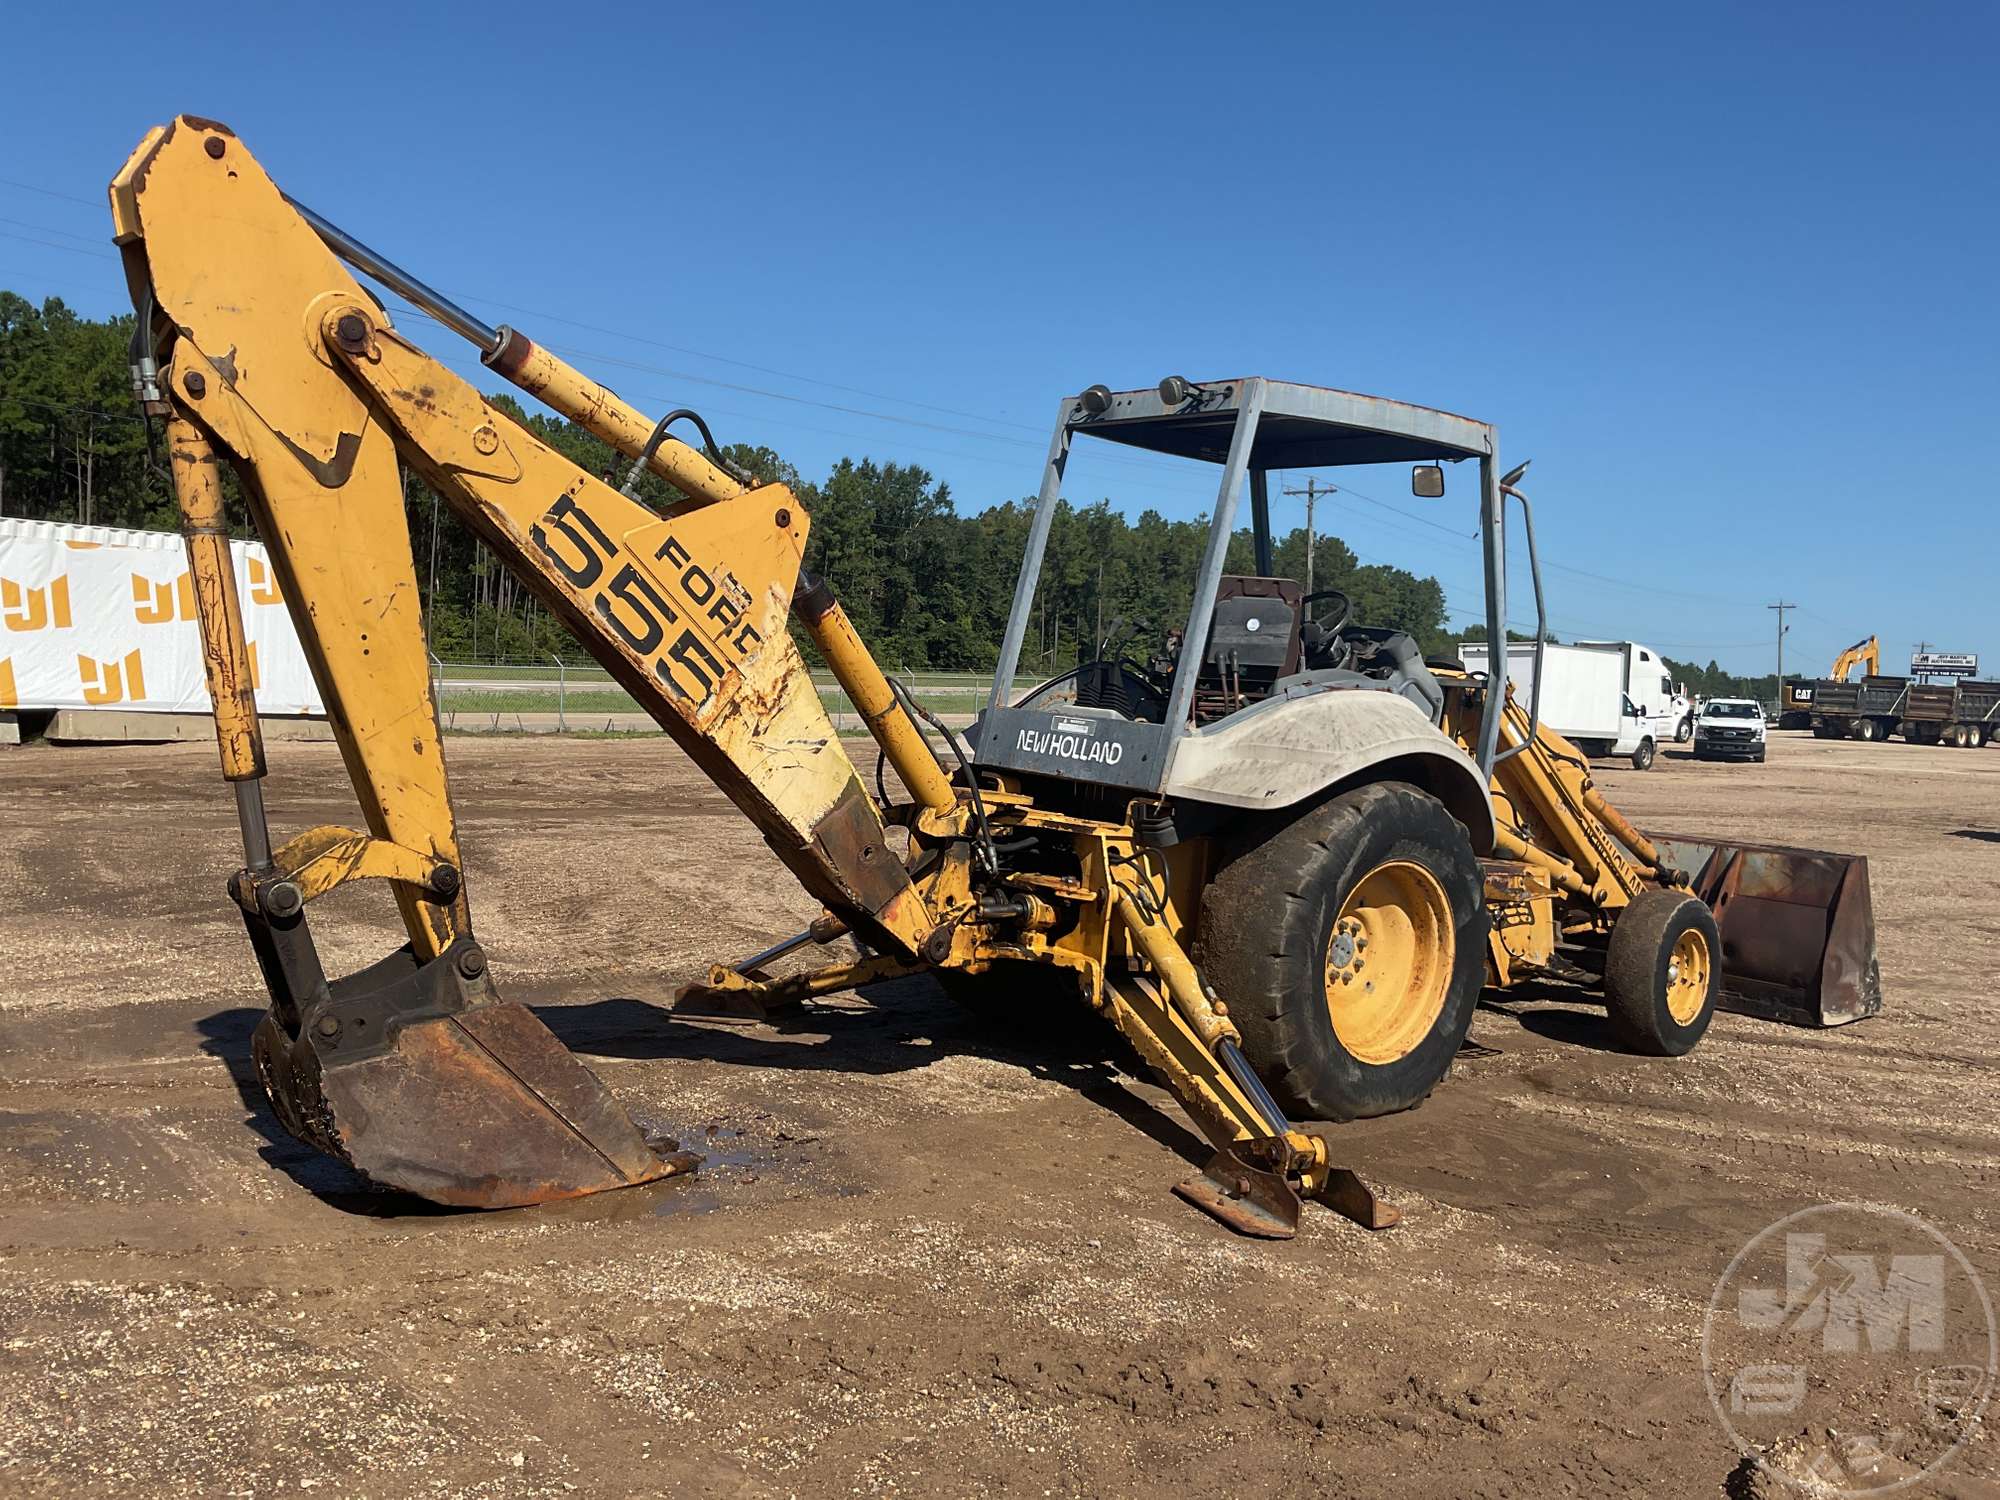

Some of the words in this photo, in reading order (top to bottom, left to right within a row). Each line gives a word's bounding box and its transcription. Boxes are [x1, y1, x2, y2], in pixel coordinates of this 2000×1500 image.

[1795, 688, 1812, 700] CAT
[1017, 729, 1050, 754] NEW
[1049, 734, 1122, 766] HOLLAND
